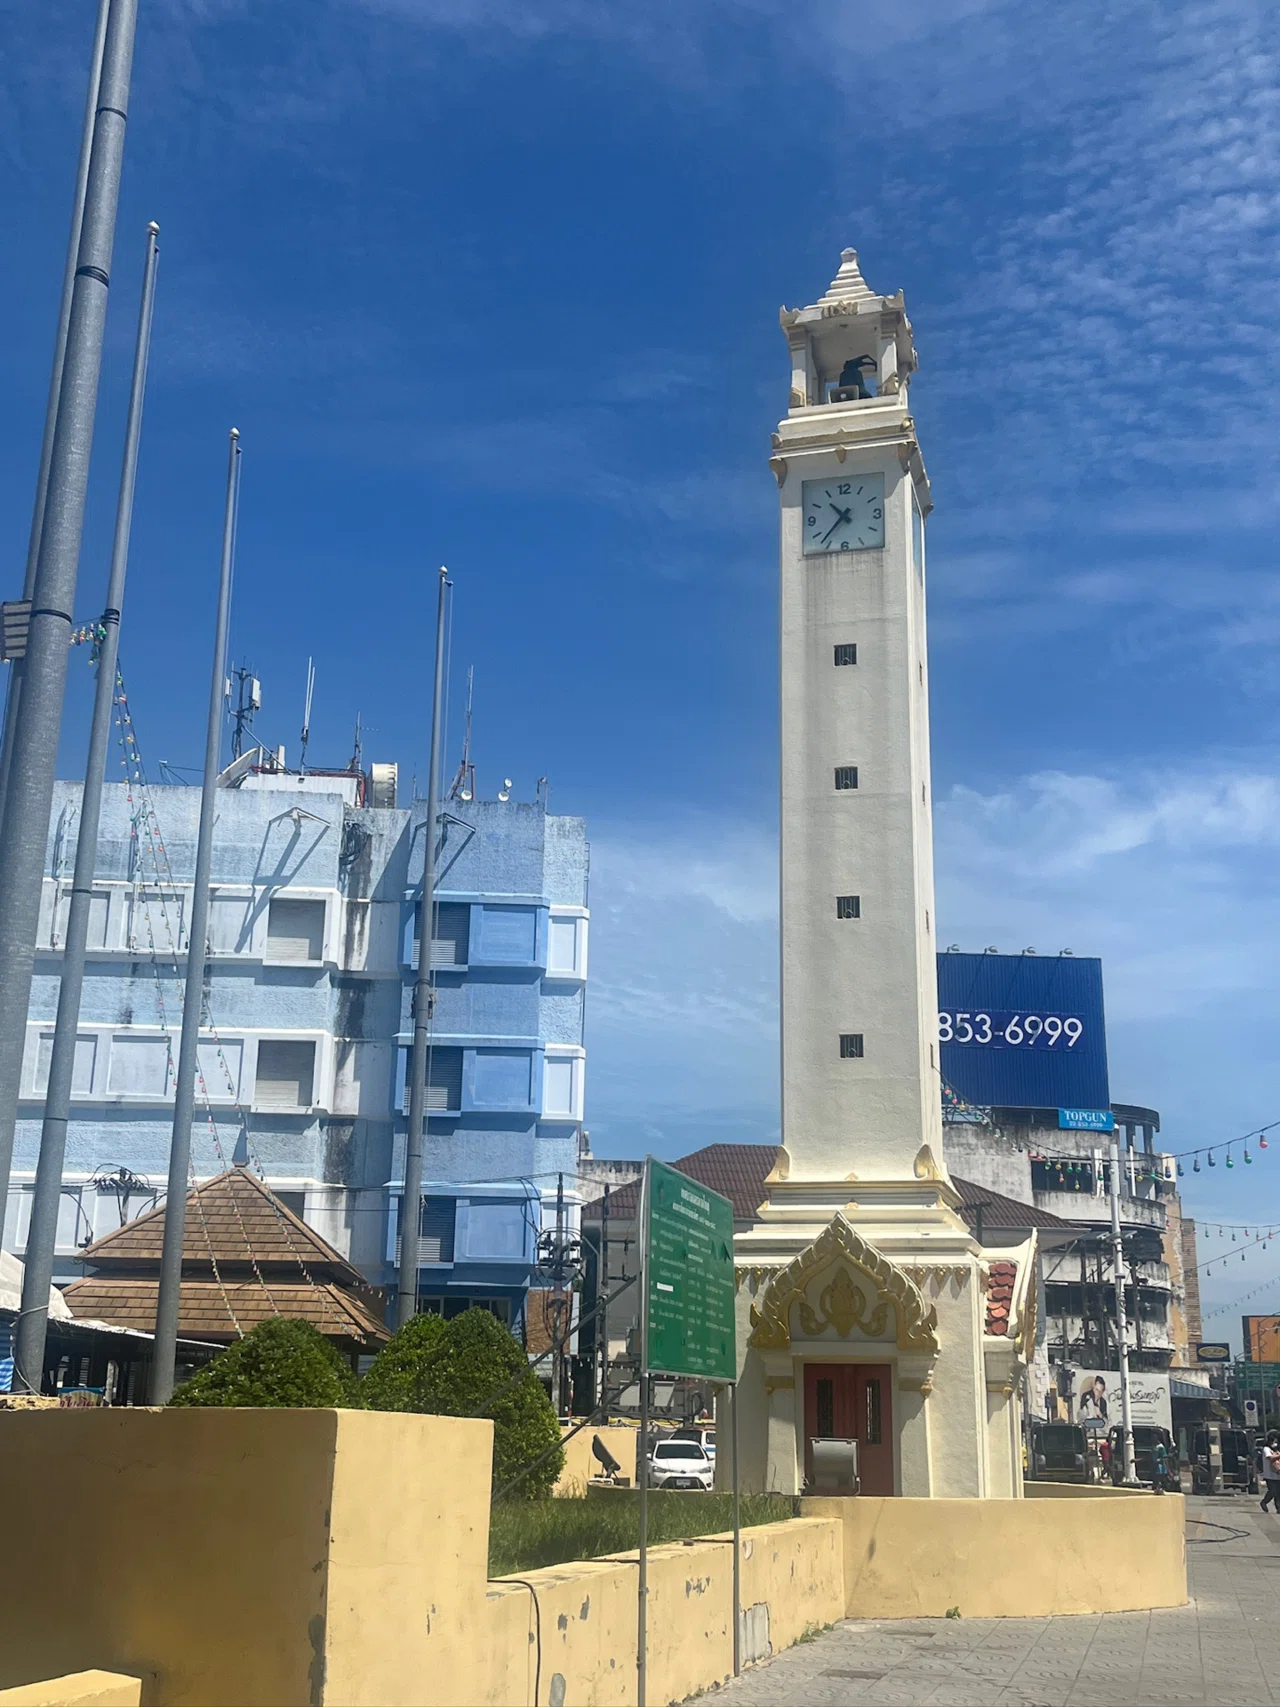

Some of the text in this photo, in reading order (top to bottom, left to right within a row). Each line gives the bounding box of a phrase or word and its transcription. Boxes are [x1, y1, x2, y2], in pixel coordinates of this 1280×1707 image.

[837, 483, 851, 495] 12
[873, 508, 882, 519] 3
[807, 516, 816, 527] 9
[840, 541, 849, 551] 6
[1064, 1110, 1107, 1122] TOPGUN
